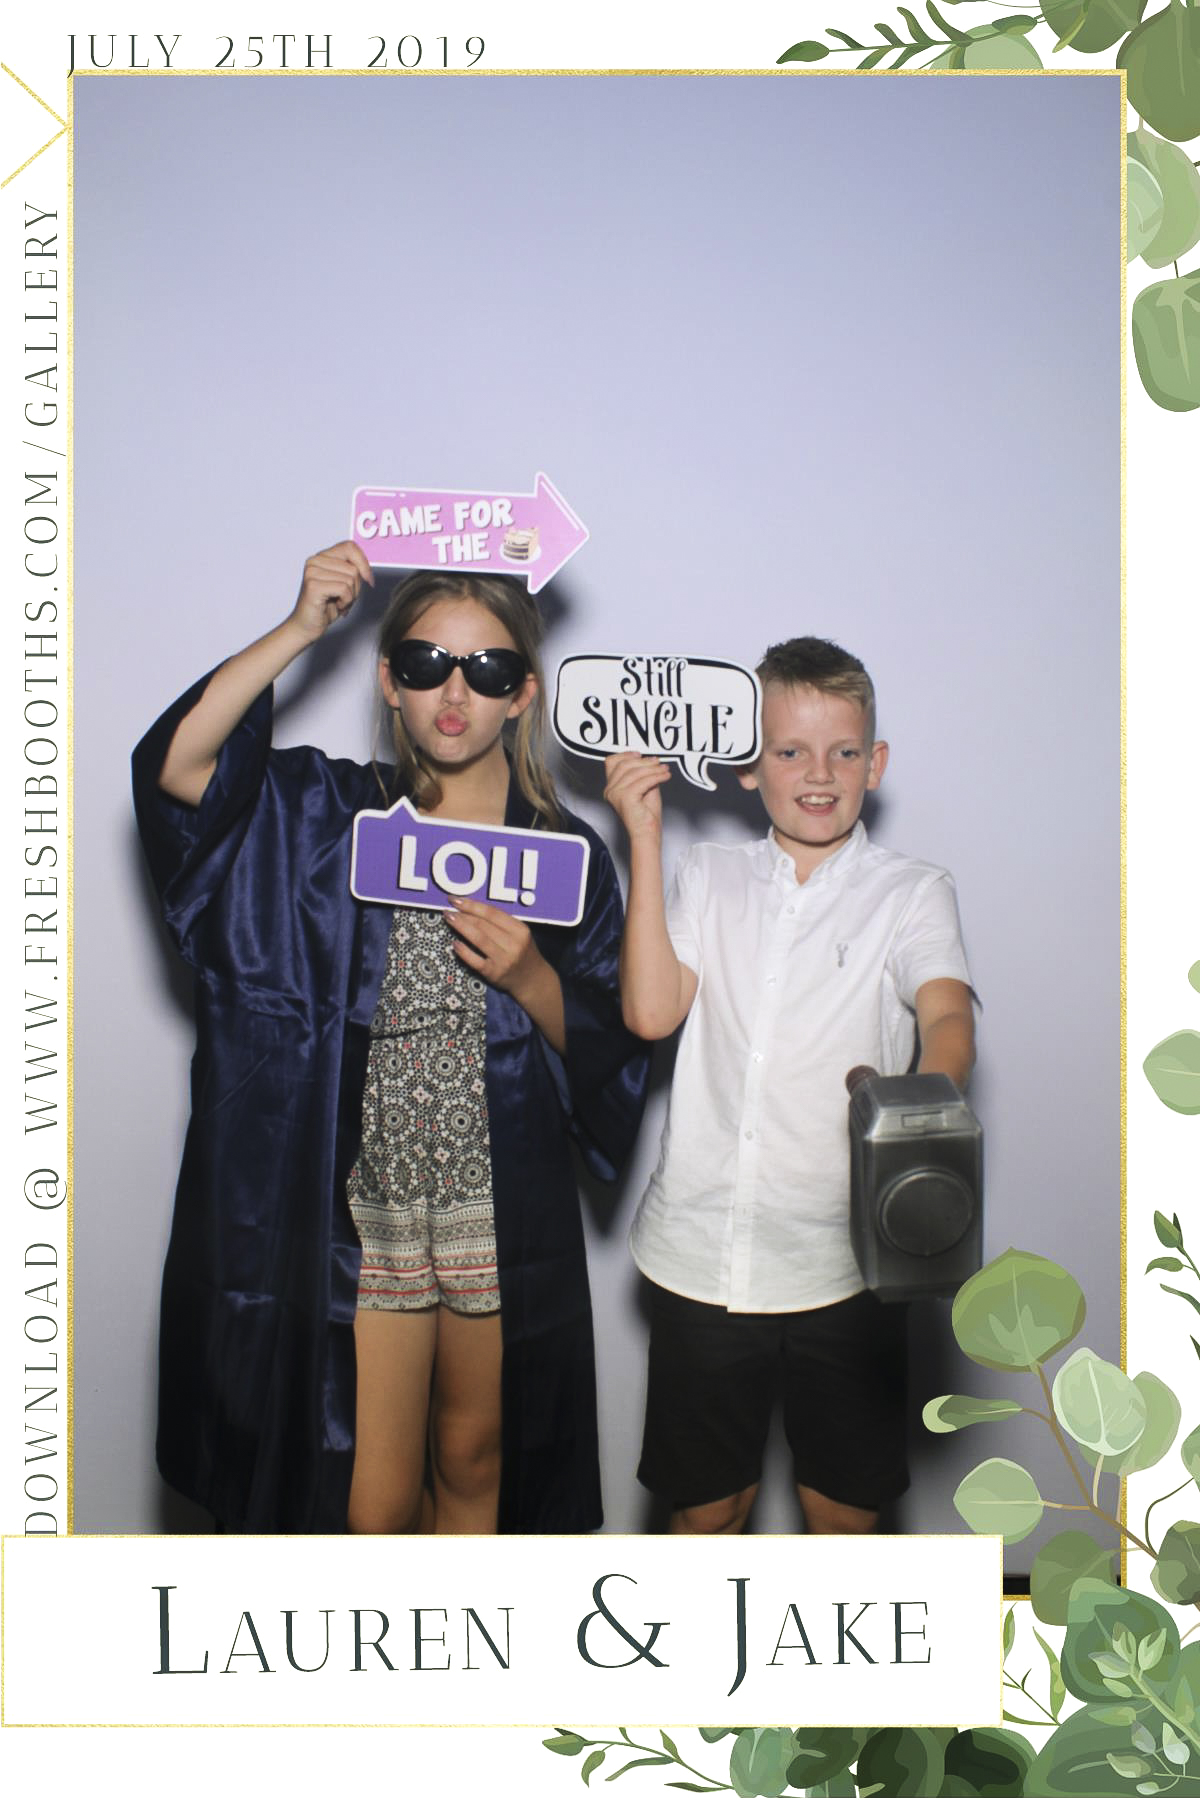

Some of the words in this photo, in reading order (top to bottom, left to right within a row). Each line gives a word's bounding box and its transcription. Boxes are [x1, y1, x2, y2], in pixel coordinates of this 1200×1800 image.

[356, 504, 443, 539] CAME
[453, 498, 515, 531] FOR
[431, 532, 491, 563] THE
[620, 657, 687, 698] Still
[579, 695, 735, 755] SINGLE
[399, 834, 539, 906] LOL!
